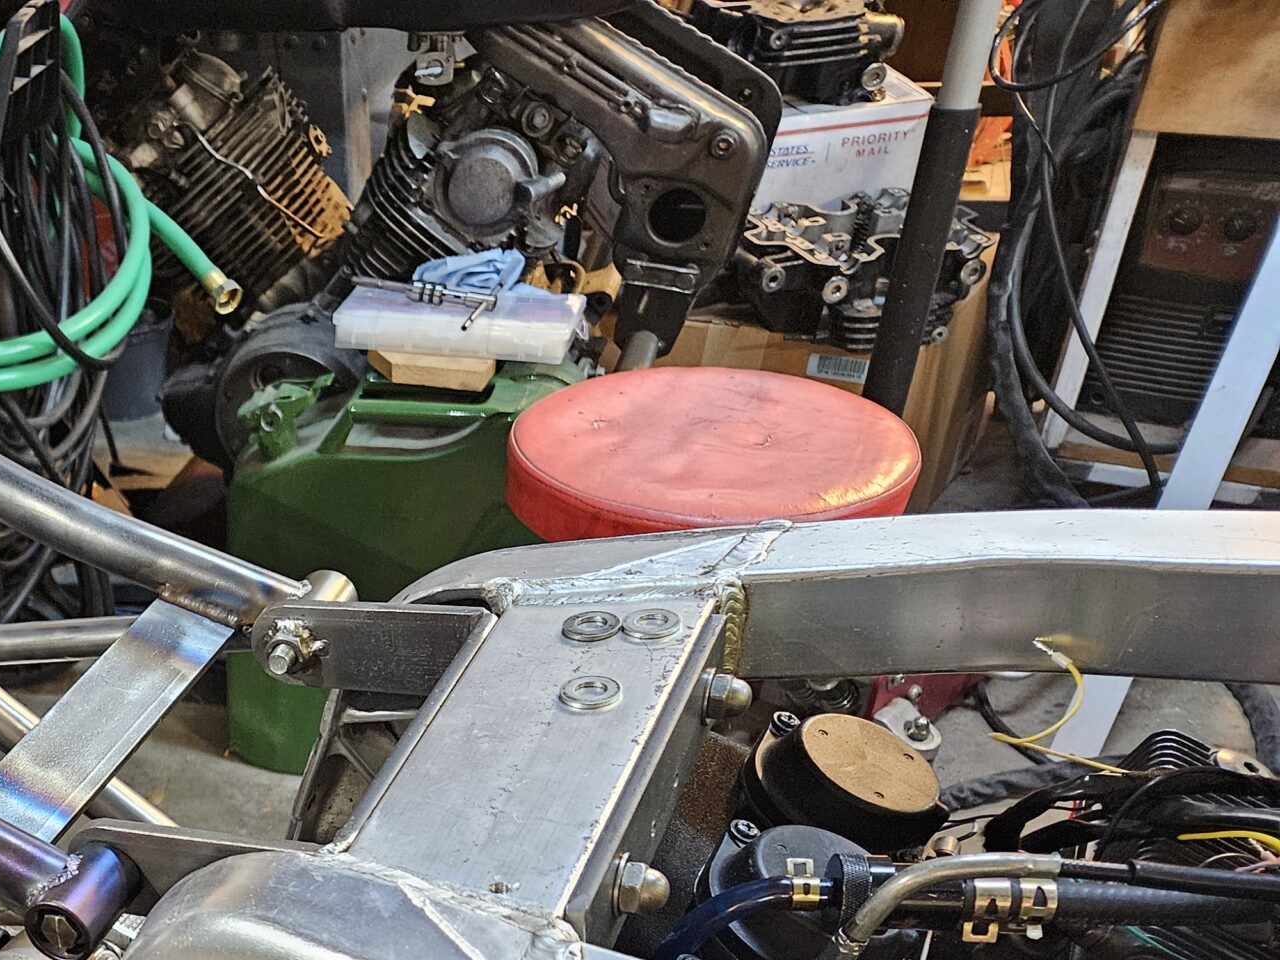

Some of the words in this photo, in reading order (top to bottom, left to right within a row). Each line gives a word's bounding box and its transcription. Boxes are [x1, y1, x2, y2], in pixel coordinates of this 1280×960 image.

[841, 130, 909, 148] PRIORITY
[770, 143, 809, 157] STATES
[855, 147, 890, 158] MAIL
